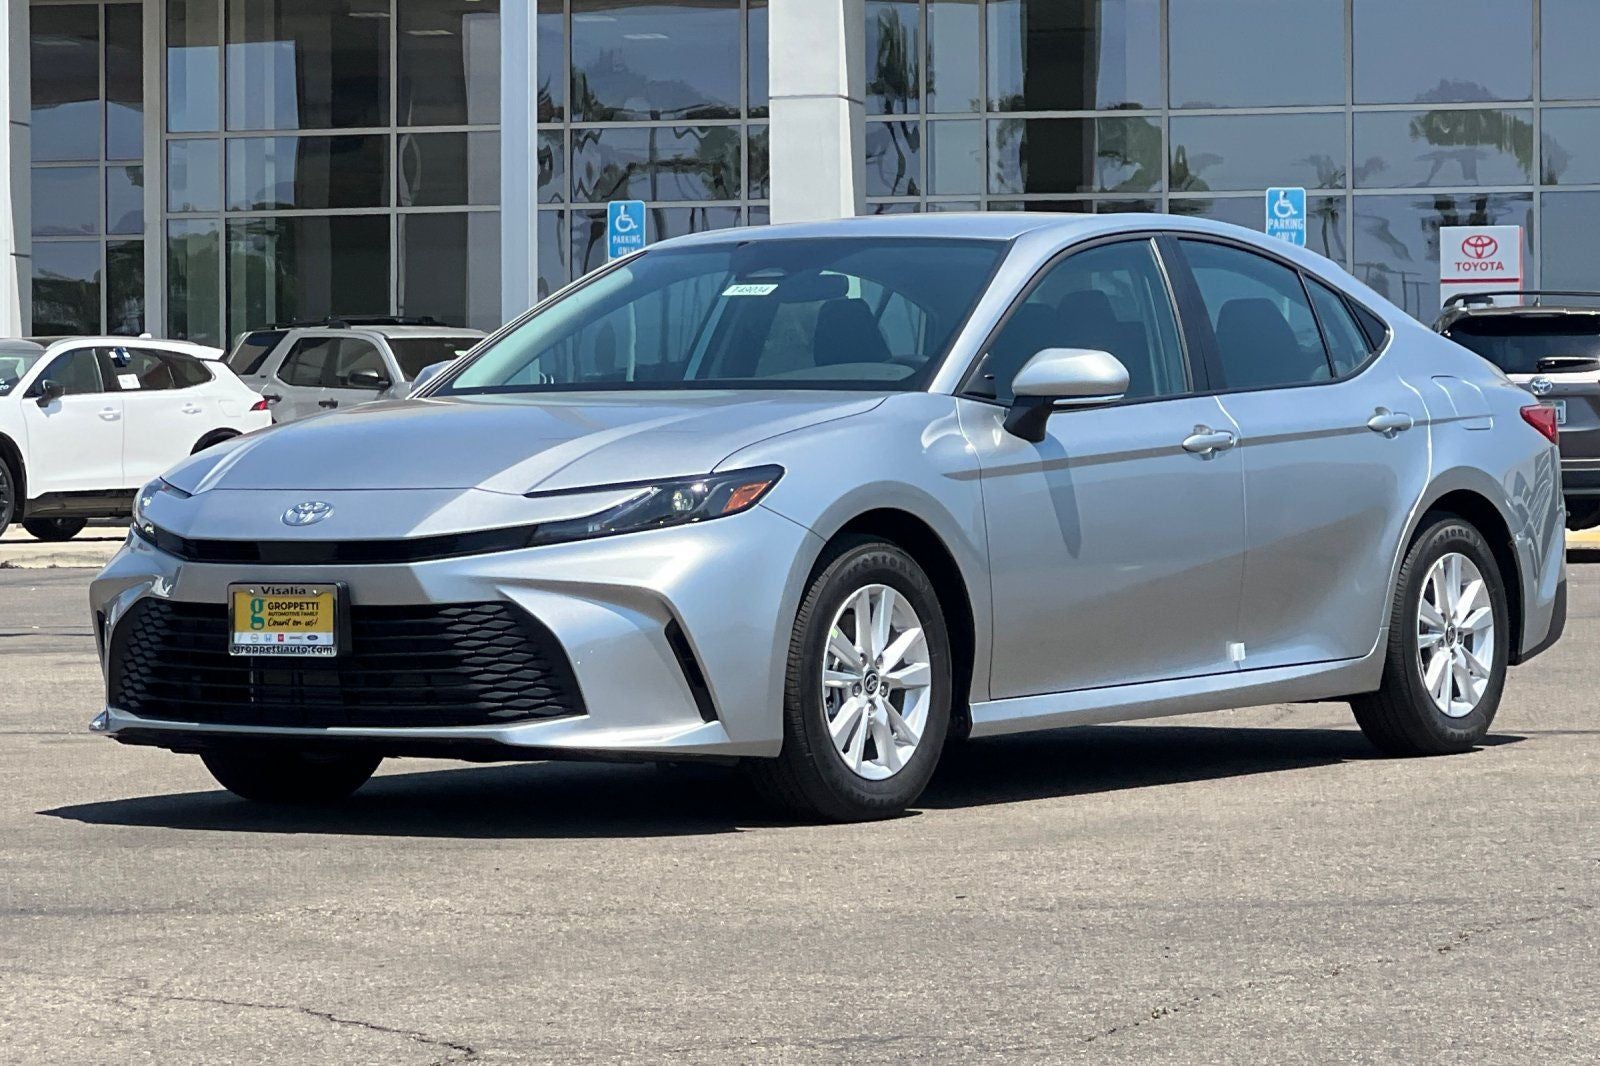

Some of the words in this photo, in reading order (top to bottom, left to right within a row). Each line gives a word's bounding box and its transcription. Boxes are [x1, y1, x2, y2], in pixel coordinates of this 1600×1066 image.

[1268, 218, 1303, 230] PARKING
[612, 235, 641, 244] PARKING
[1455, 262, 1504, 271] TOYOTA
[261, 586, 306, 595] Visalia
[267, 602, 319, 610] GROPPETTI
[268, 617, 291, 626] Count
[233, 645, 333, 655] groppettiauto.com
